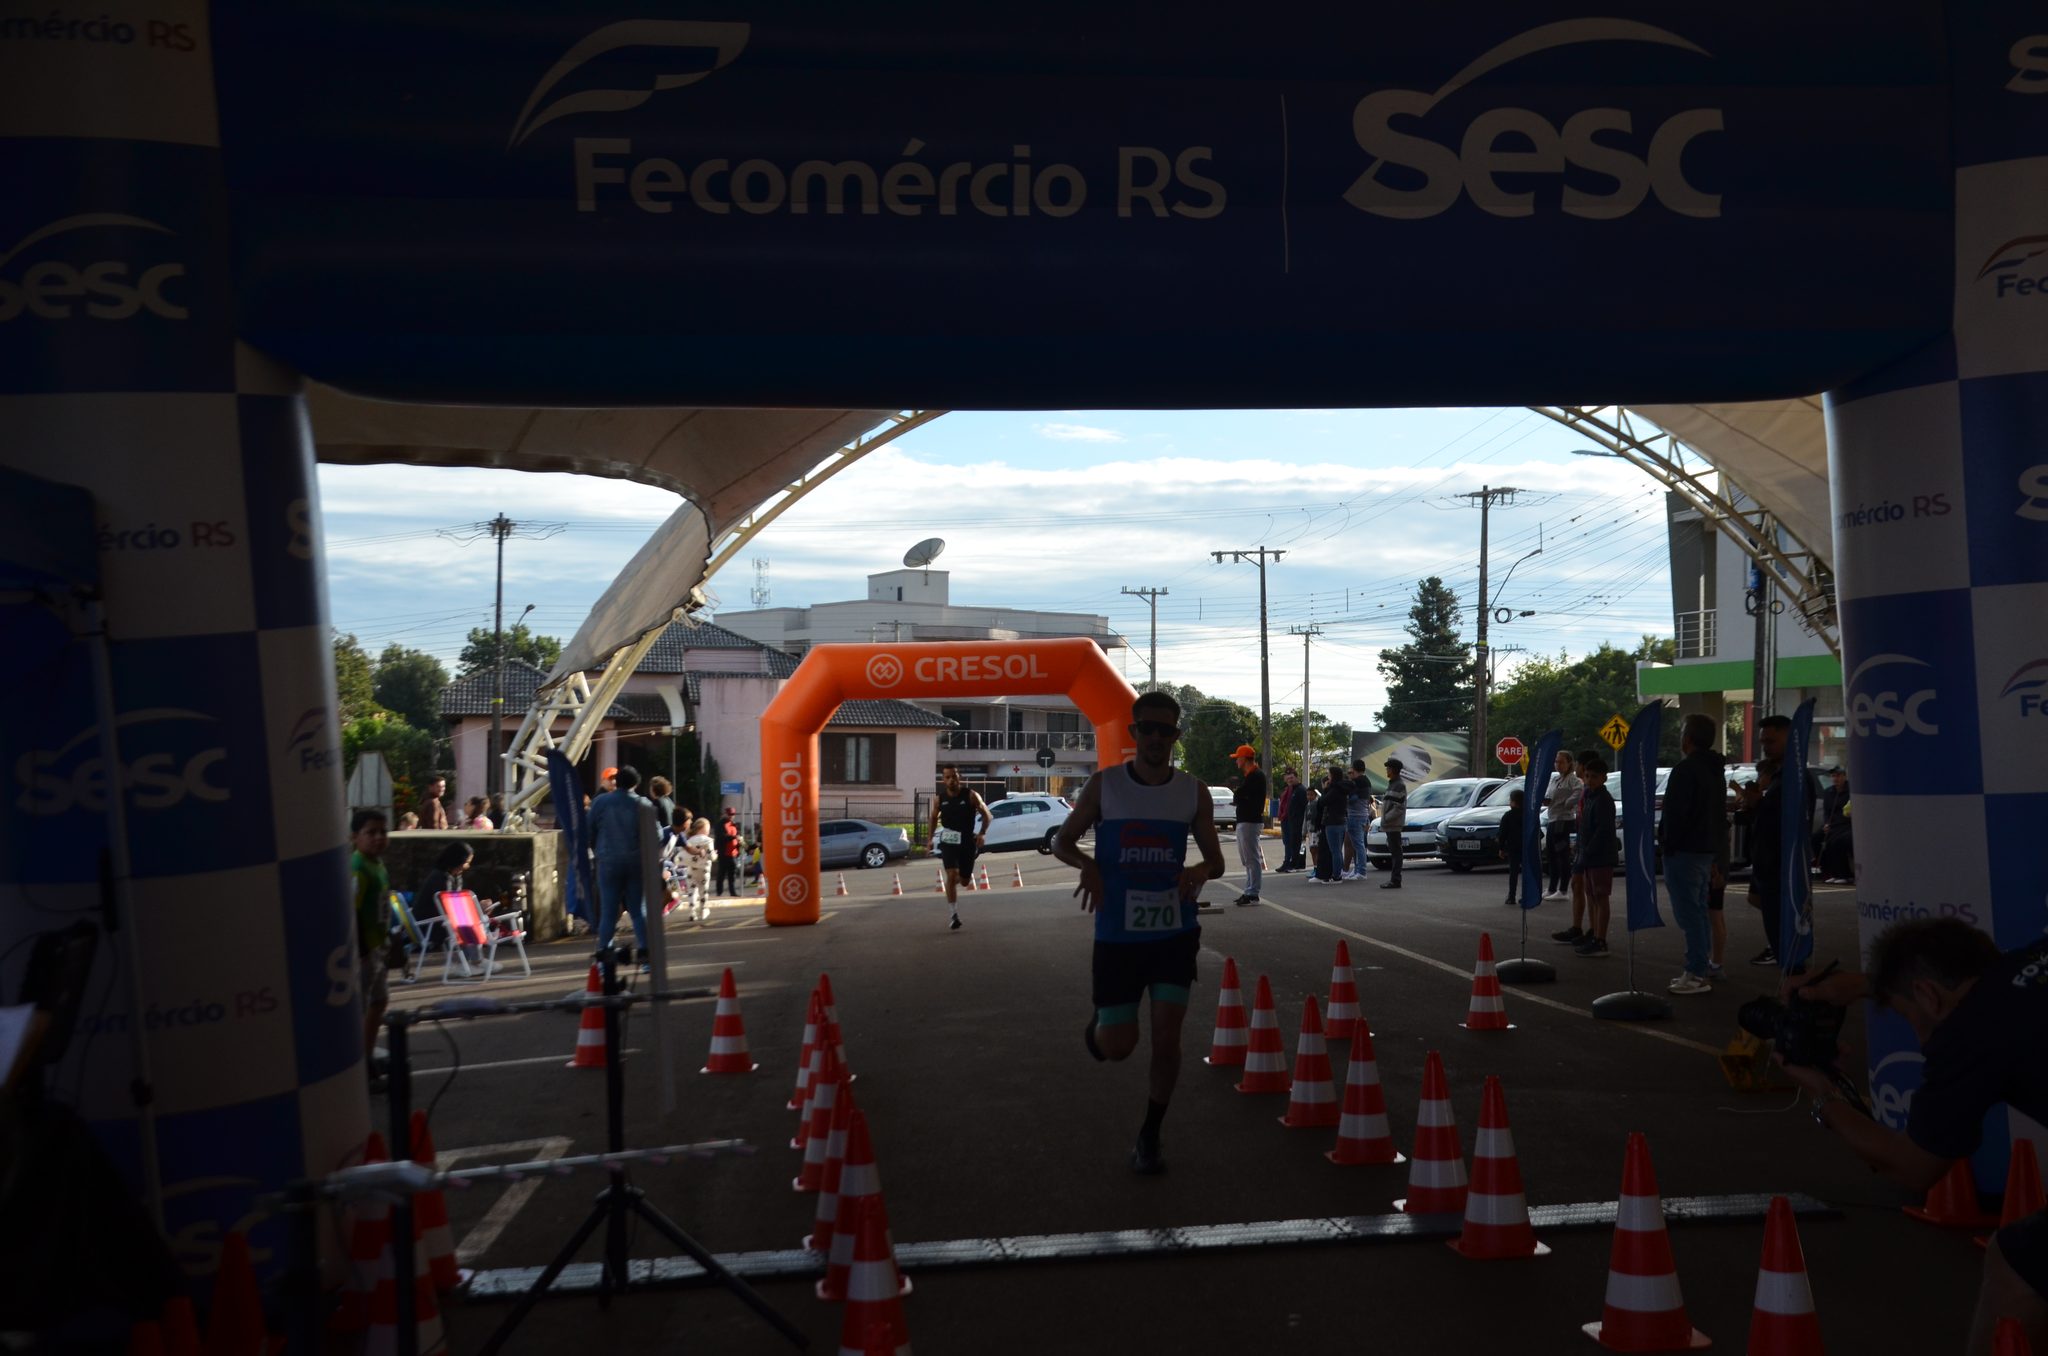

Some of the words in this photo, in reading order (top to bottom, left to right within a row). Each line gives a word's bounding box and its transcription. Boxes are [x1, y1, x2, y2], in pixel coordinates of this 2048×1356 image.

[149, 20, 196, 52] RS
[1343, 88, 1726, 220] Sesc
[573, 137, 1088, 219] Fecomércio
[1117, 146, 1229, 219] RS
[1913, 492, 1952, 518] RS
[191, 521, 235, 547] RS
[913, 653, 1048, 683] CRESOL
[1849, 688, 1940, 738] esc
[1497, 746, 1522, 756] PARE
[780, 752, 803, 865] CRESOL
[1118, 847, 1177, 864] JAIME
[1133, 904, 1174, 928] 270
[234, 986, 279, 1020] RS
